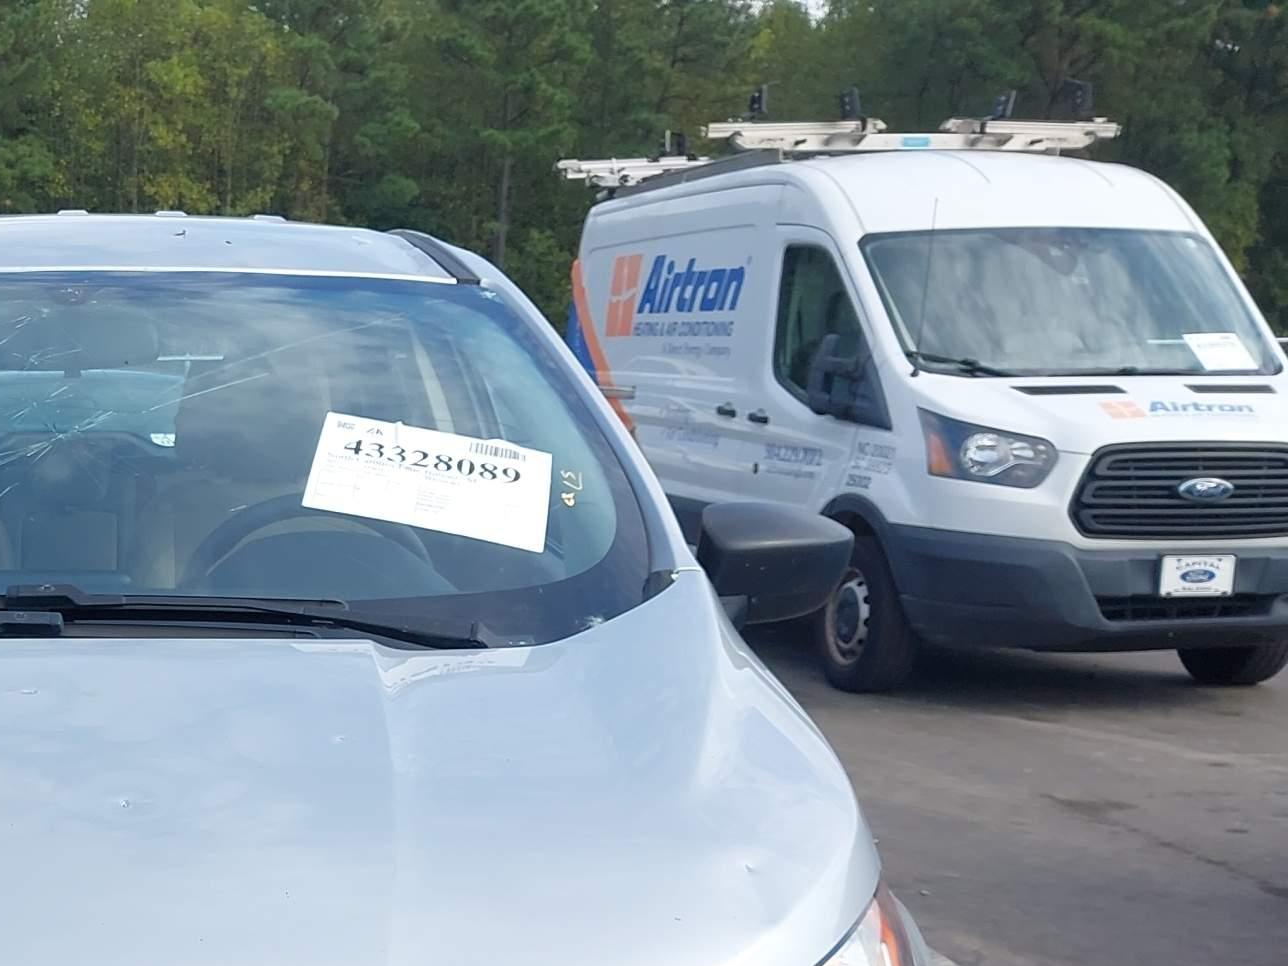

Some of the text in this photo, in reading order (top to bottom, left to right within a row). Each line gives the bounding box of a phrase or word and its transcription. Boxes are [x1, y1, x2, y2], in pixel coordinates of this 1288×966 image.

[636, 254, 745, 314] Airtron
[1149, 400, 1254, 412] Airtron
[343, 439, 521, 484] 43328089
